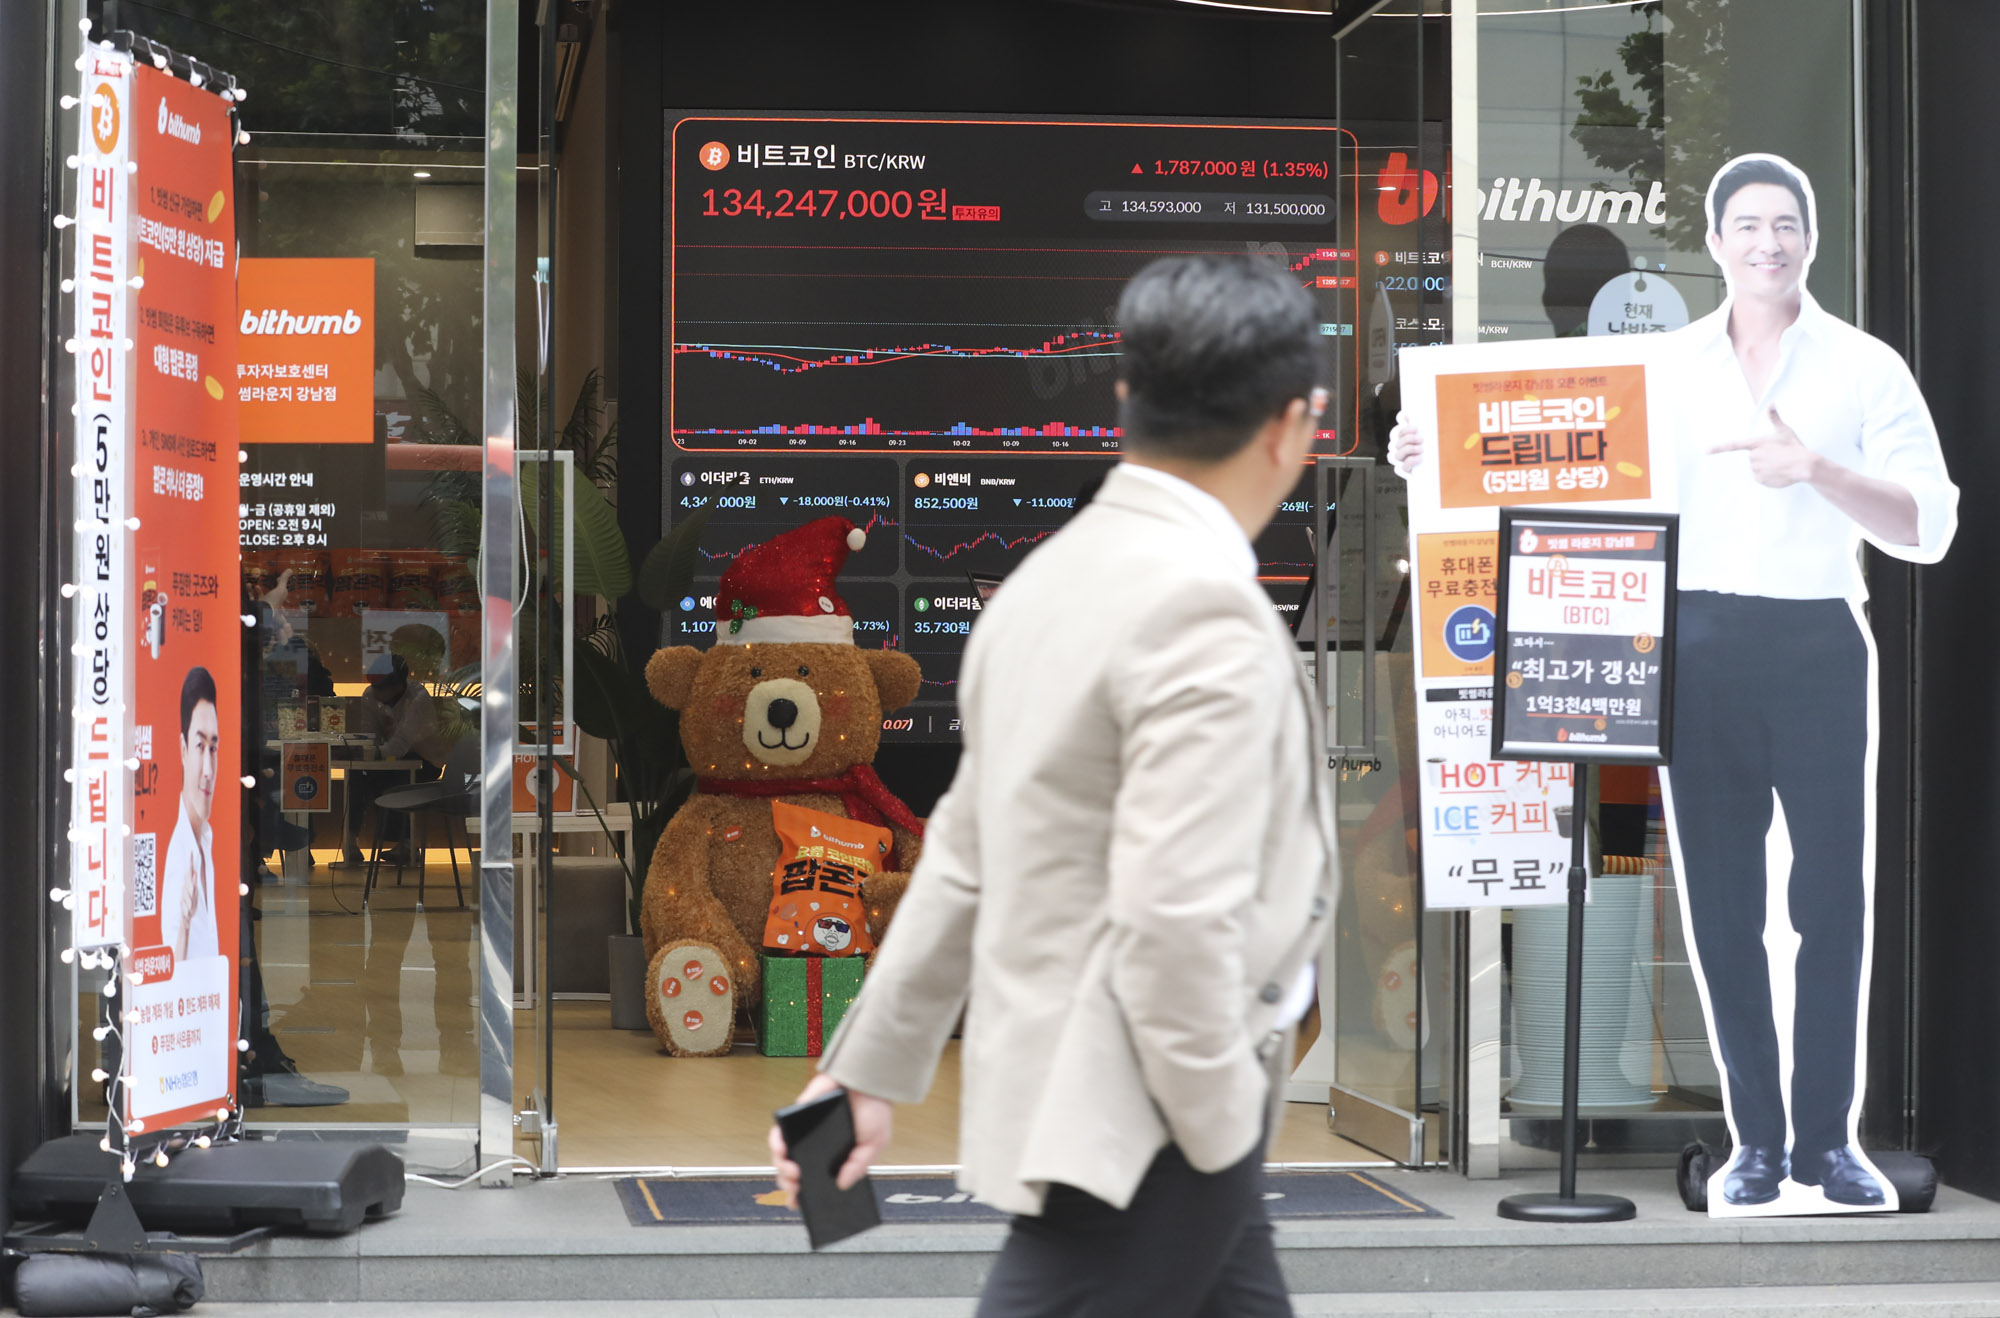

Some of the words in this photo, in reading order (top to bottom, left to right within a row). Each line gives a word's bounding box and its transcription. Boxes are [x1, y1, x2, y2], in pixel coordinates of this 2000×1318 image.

[168, 111, 201, 145] bithumb
[737, 143, 836, 169] 비트코인
[844, 154, 926, 171] BTC/KRW
[1154, 160, 1237, 177] 1,787,000
[1263, 161, 1329, 180] (1.35%)
[954, 207, 999, 220] 투자유의
[1099, 201, 1113, 213] 고
[1122, 201, 1202, 215] 134,593,000
[1224, 202, 1236, 216] 저
[1246, 203, 1326, 217] 131,500,000
[1491, 260, 1533, 270] BCH/KRW
[1624, 302, 1653, 320] 현재
[240, 309, 362, 335] bithumb
[296, 386, 337, 402] 강남점
[1478, 396, 1606, 434] 비트코인
[839, 439, 857, 447] 09-16
[889, 439, 907, 447] 09-23
[1480, 430, 1608, 466] 드립니다
[238, 473, 287, 488] 운영시간
[289, 473, 314, 487] 안내
[759, 476, 794, 485] ETH/KRW
[934, 472, 971, 487] 비앤비
[980, 478, 1016, 486] BNB/KRW
[1482, 468, 1550, 494] (5만원
[1555, 464, 1609, 490] 상당)
[268, 503, 306, 518] (공휴일
[309, 503, 336, 517] 제외)
[914, 498, 979, 510] 852,500원
[239, 519, 275, 532] OPEN:
[277, 519, 299, 532] 오전
[239, 534, 280, 547] CLOSE:
[282, 533, 305, 547] 오후
[1440, 557, 1494, 576] 휴대폰
[1528, 568, 1648, 603] 비트코인
[914, 621, 970, 634] 35,730원
[1526, 695, 1642, 717] 1억3천4백만원
[1433, 725, 1489, 738] 아니어도
[1440, 763, 1505, 788] HOT
[1515, 761, 1575, 788] 커피
[1433, 805, 1480, 831] ICE
[1490, 800, 1548, 832] 커피
[823, 834, 865, 849] bithumb
